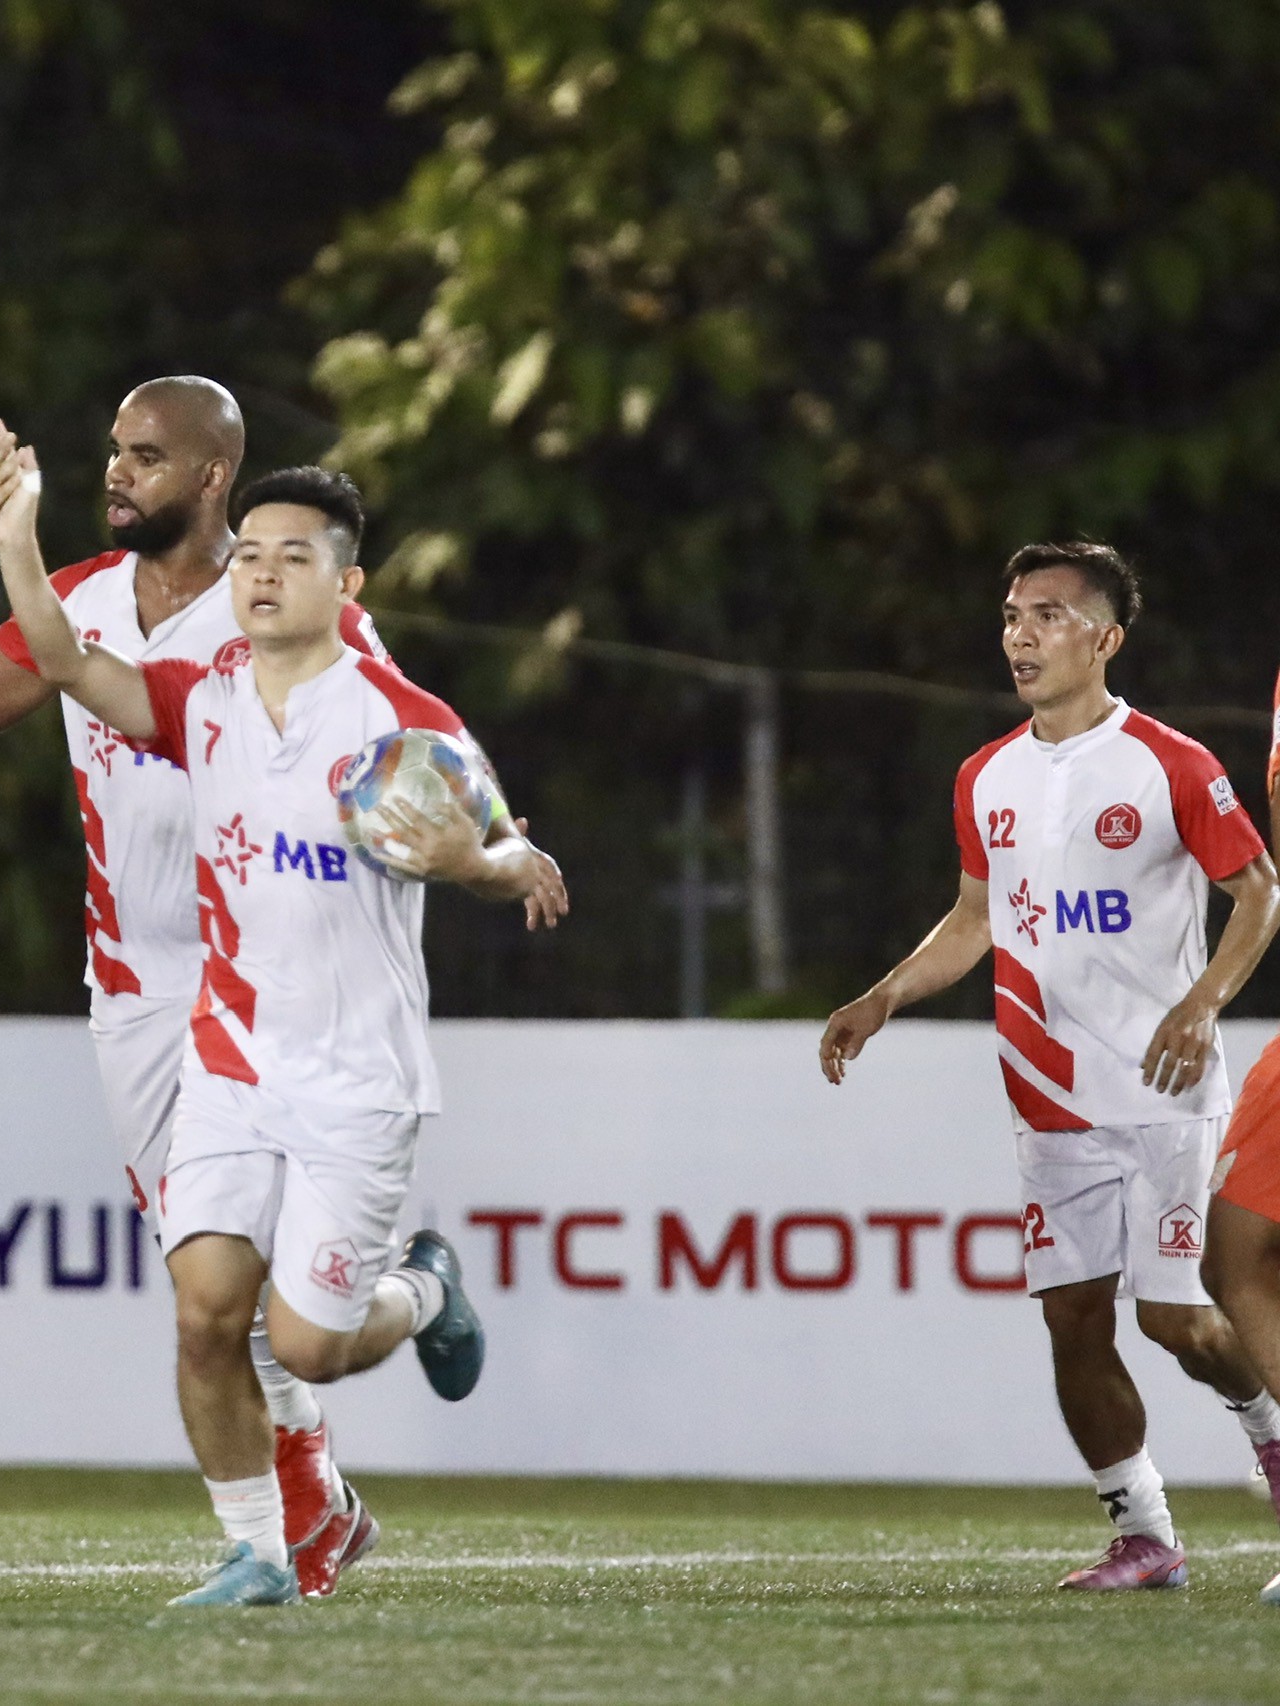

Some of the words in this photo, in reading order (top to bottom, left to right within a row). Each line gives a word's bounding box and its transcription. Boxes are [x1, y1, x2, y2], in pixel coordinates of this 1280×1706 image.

[204, 719, 222, 765] 7
[988, 808, 1016, 848] 22
[273, 831, 348, 882] MB
[1056, 889, 1132, 934] MB
[468, 1211, 623, 1292] TC
